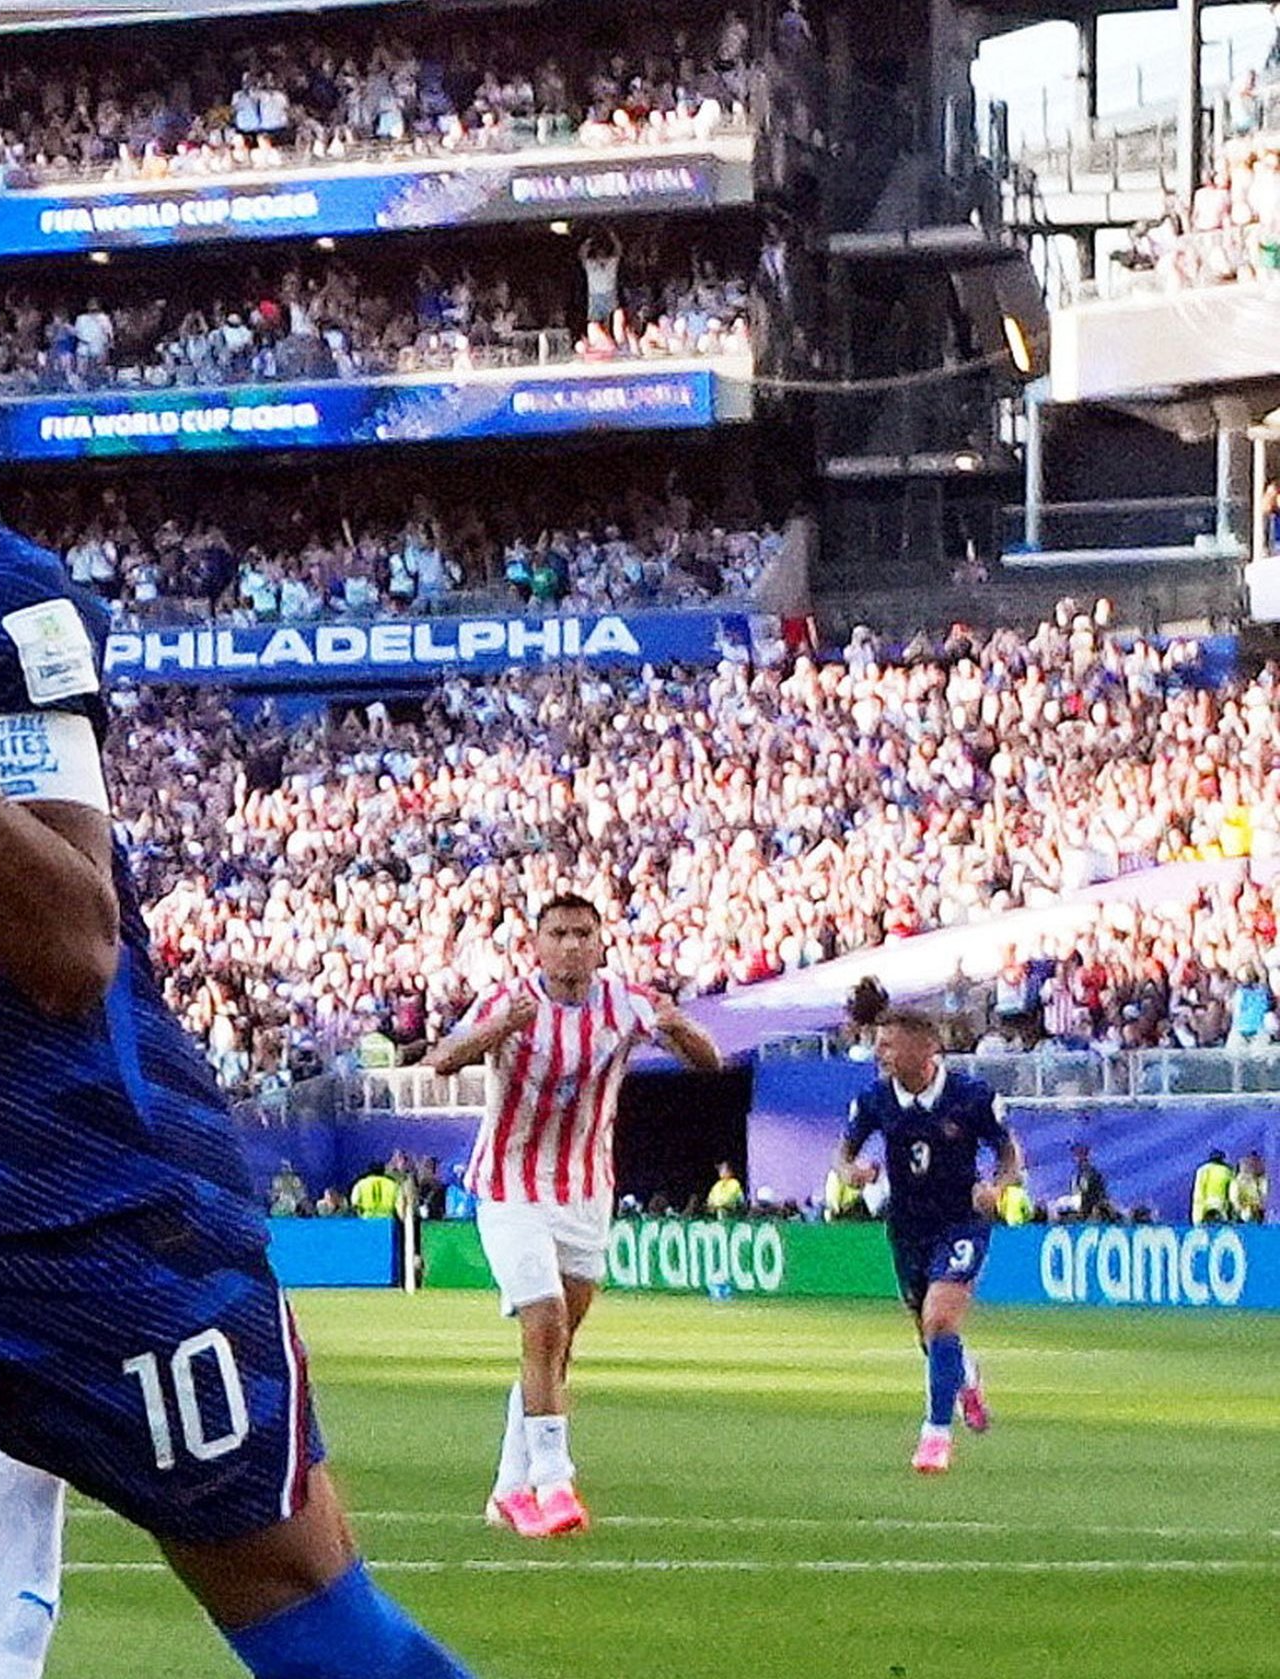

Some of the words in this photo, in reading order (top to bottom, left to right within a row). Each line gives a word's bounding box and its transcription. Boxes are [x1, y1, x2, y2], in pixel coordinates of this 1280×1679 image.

[40, 208, 93, 234] FIFA
[92, 202, 179, 231] WORLD
[181, 200, 230, 226] CUP
[40, 415, 92, 440] FIFA
[93, 410, 179, 438] WORLD
[181, 408, 230, 433] CUP
[102, 616, 641, 673] PHILADELPHIA
[608, 1220, 784, 1292] aramco
[1040, 1226, 1247, 1306] aramco
[121, 1327, 250, 1471] 10
